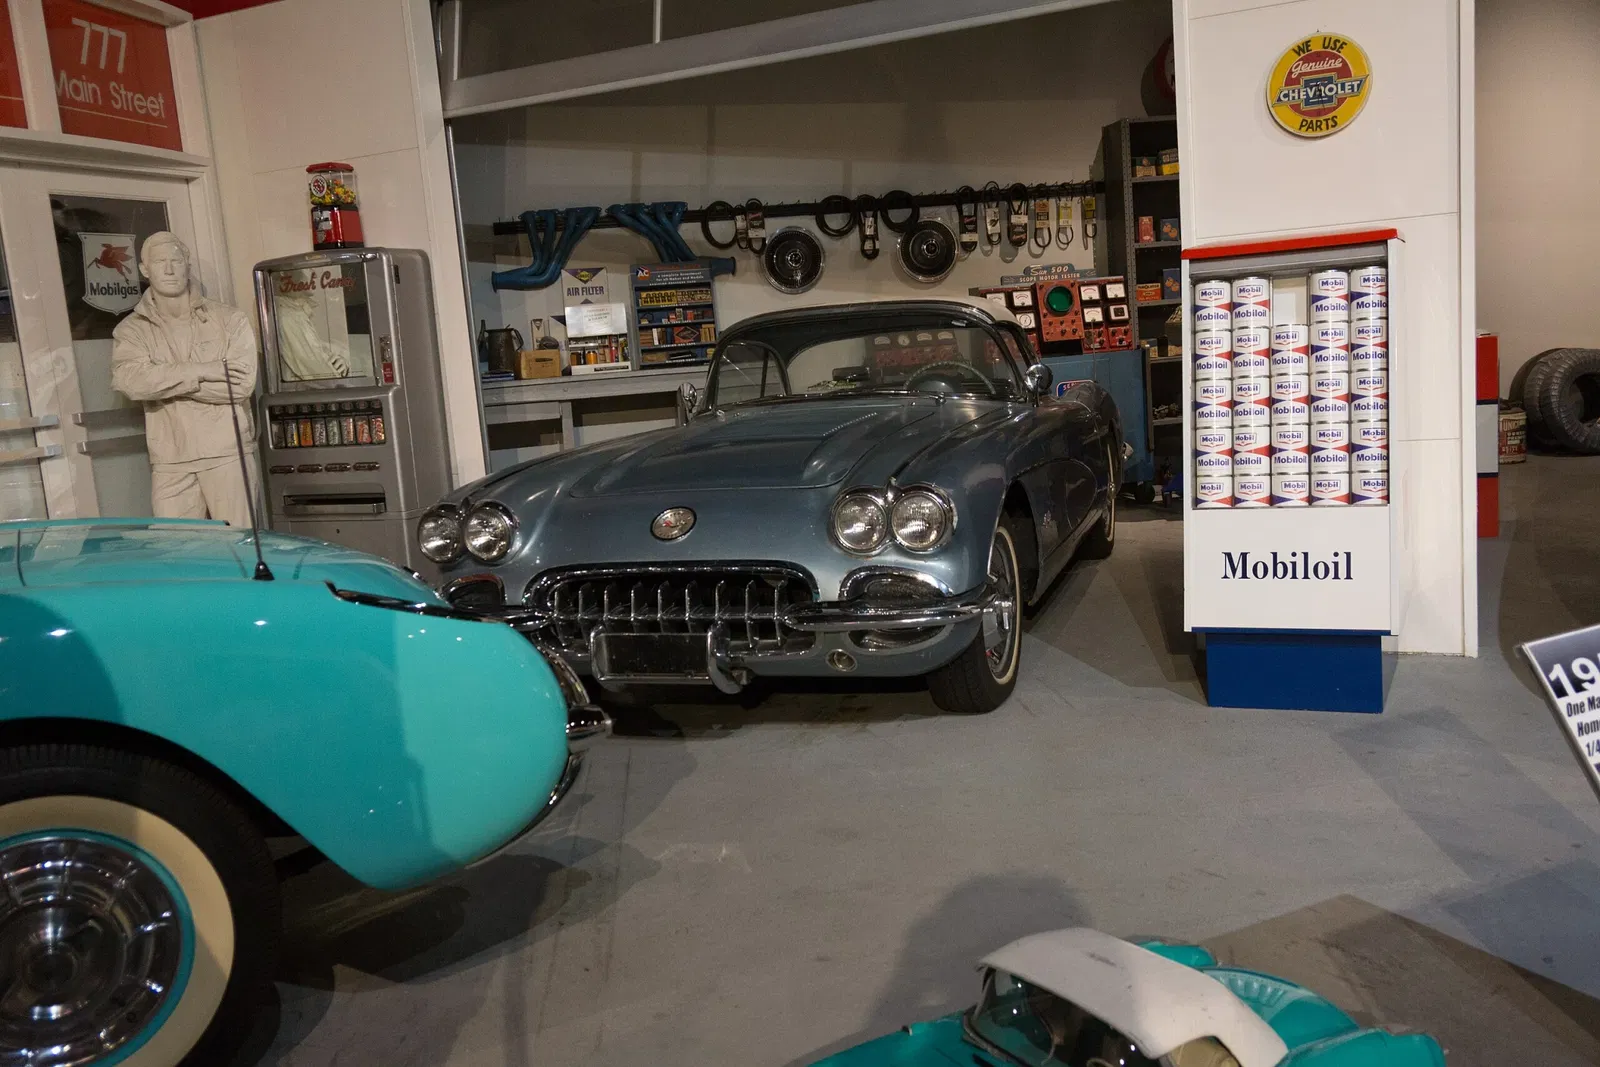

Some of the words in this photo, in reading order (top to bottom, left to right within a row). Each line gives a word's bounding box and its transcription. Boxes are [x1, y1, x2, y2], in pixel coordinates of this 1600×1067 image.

[72, 17, 127, 73] 777
[1292, 40, 1312, 56] WE
[1322, 37, 1347, 53] USE
[1291, 57, 1343, 78] Genuine
[56, 70, 102, 105] Main
[109, 81, 165, 118] Street
[1279, 80, 1361, 102] CHEVROLET
[1298, 115, 1338, 132] PARTS
[637, 268, 649, 277] AC
[1051, 265, 1069, 273] 500
[280, 271, 316, 292] Fresh
[1362, 276, 1386, 284] Mobil
[89, 282, 139, 299] Mobilgas
[567, 286, 580, 296] AIR
[581, 285, 605, 296] FILTER
[1201, 289, 1223, 297] Mobil
[1357, 300, 1387, 309] Mobilo
[1197, 312, 1228, 321] Mobiloil
[1234, 309, 1266, 318] Mobiloil
[1358, 327, 1381, 335] Mobil
[1236, 336, 1258, 344] Mobil
[1275, 333, 1297, 341] Mobil
[1359, 378, 1382, 386] Mobil
[1237, 384, 1259, 392] Mobil
[1313, 403, 1346, 412] Mobiloil
[1198, 410, 1230, 419] Mobiloil
[1319, 430, 1342, 438] Mobil
[1234, 457, 1261, 465] obiloil
[1274, 455, 1307, 464] Mobiloil
[1314, 453, 1347, 463] Mobiloil
[1357, 453, 1387, 462] Mobilo
[1198, 458, 1230, 467] Mobiloil
[1200, 483, 1222, 491] Mobil
[1239, 482, 1262, 490] Mobil
[1316, 481, 1338, 489] Mobil
[1363, 479, 1386, 487] Mobil
[1221, 551, 1354, 581] Mobiloil
[1549, 652, 1600, 697] 19
[1566, 701, 1586, 718] One
[1577, 720, 1600, 737] Hom
